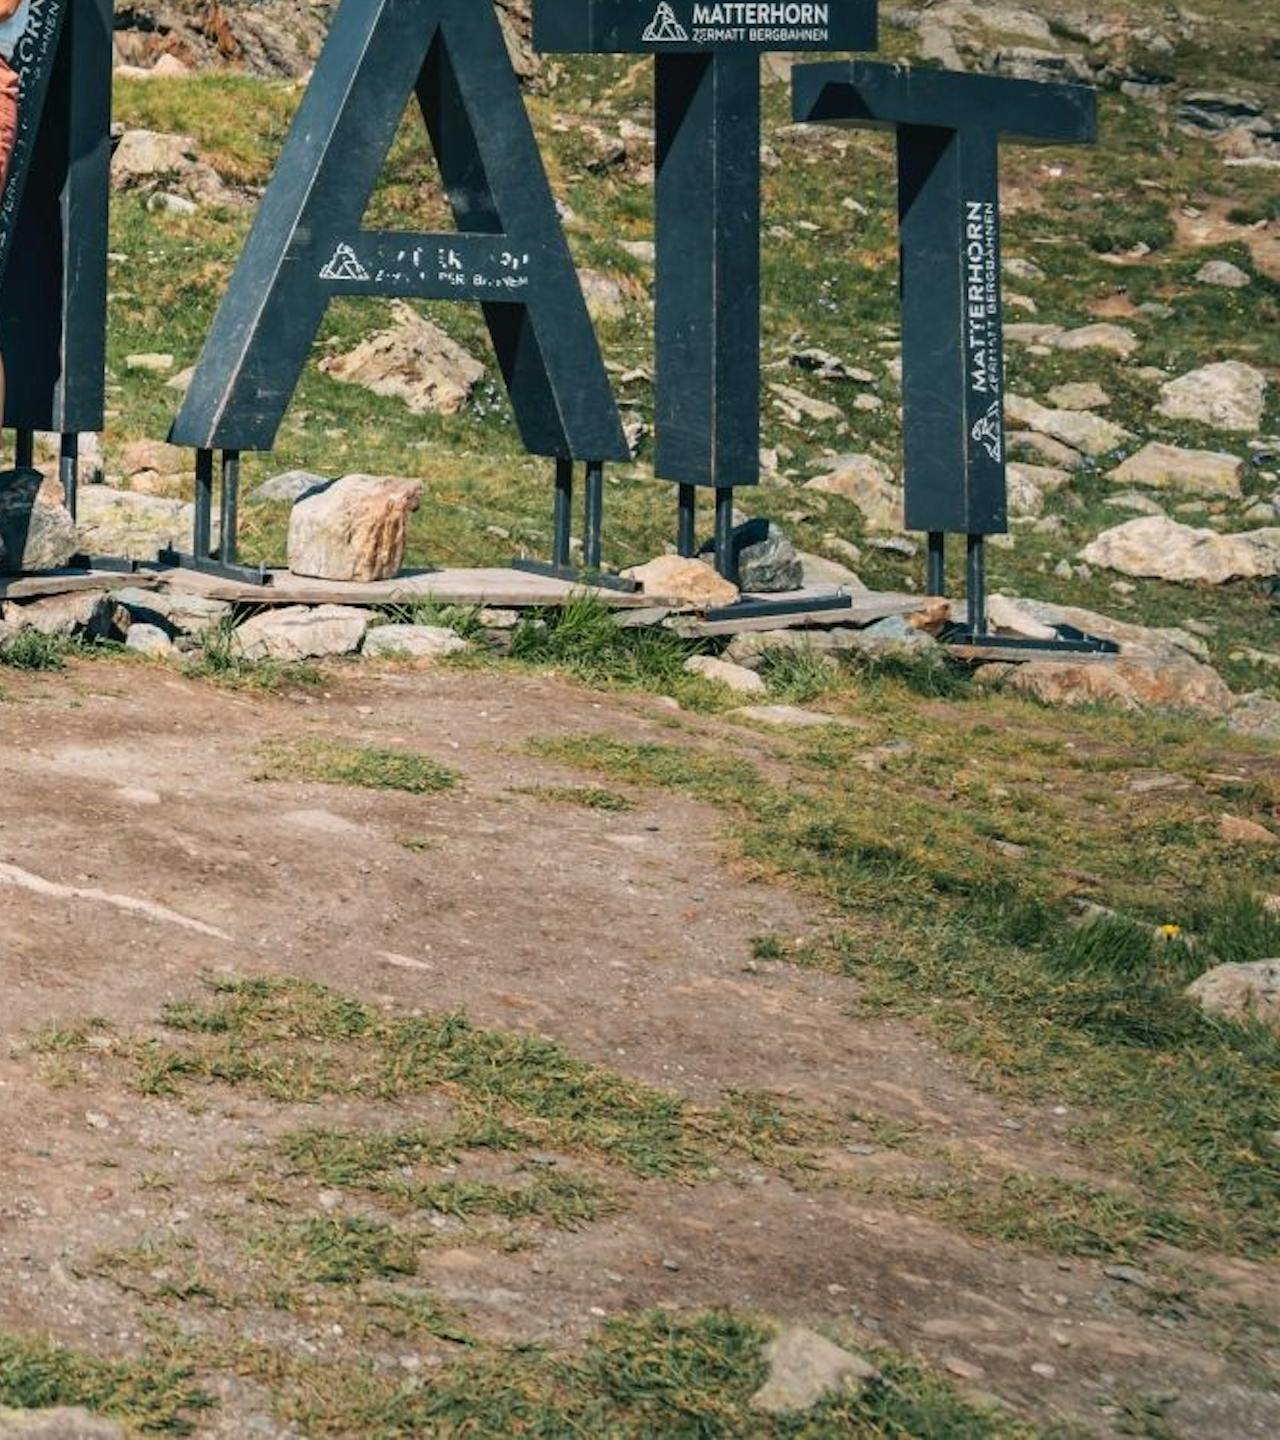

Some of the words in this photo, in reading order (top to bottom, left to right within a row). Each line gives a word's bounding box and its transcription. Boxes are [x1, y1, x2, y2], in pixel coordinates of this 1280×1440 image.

[693, 3, 828, 24] MATTERHORN
[692, 27, 746, 42] ZERMATT
[748, 27, 828, 41] BERGBAHNEN
[966, 201, 987, 392] MATTERHORN
